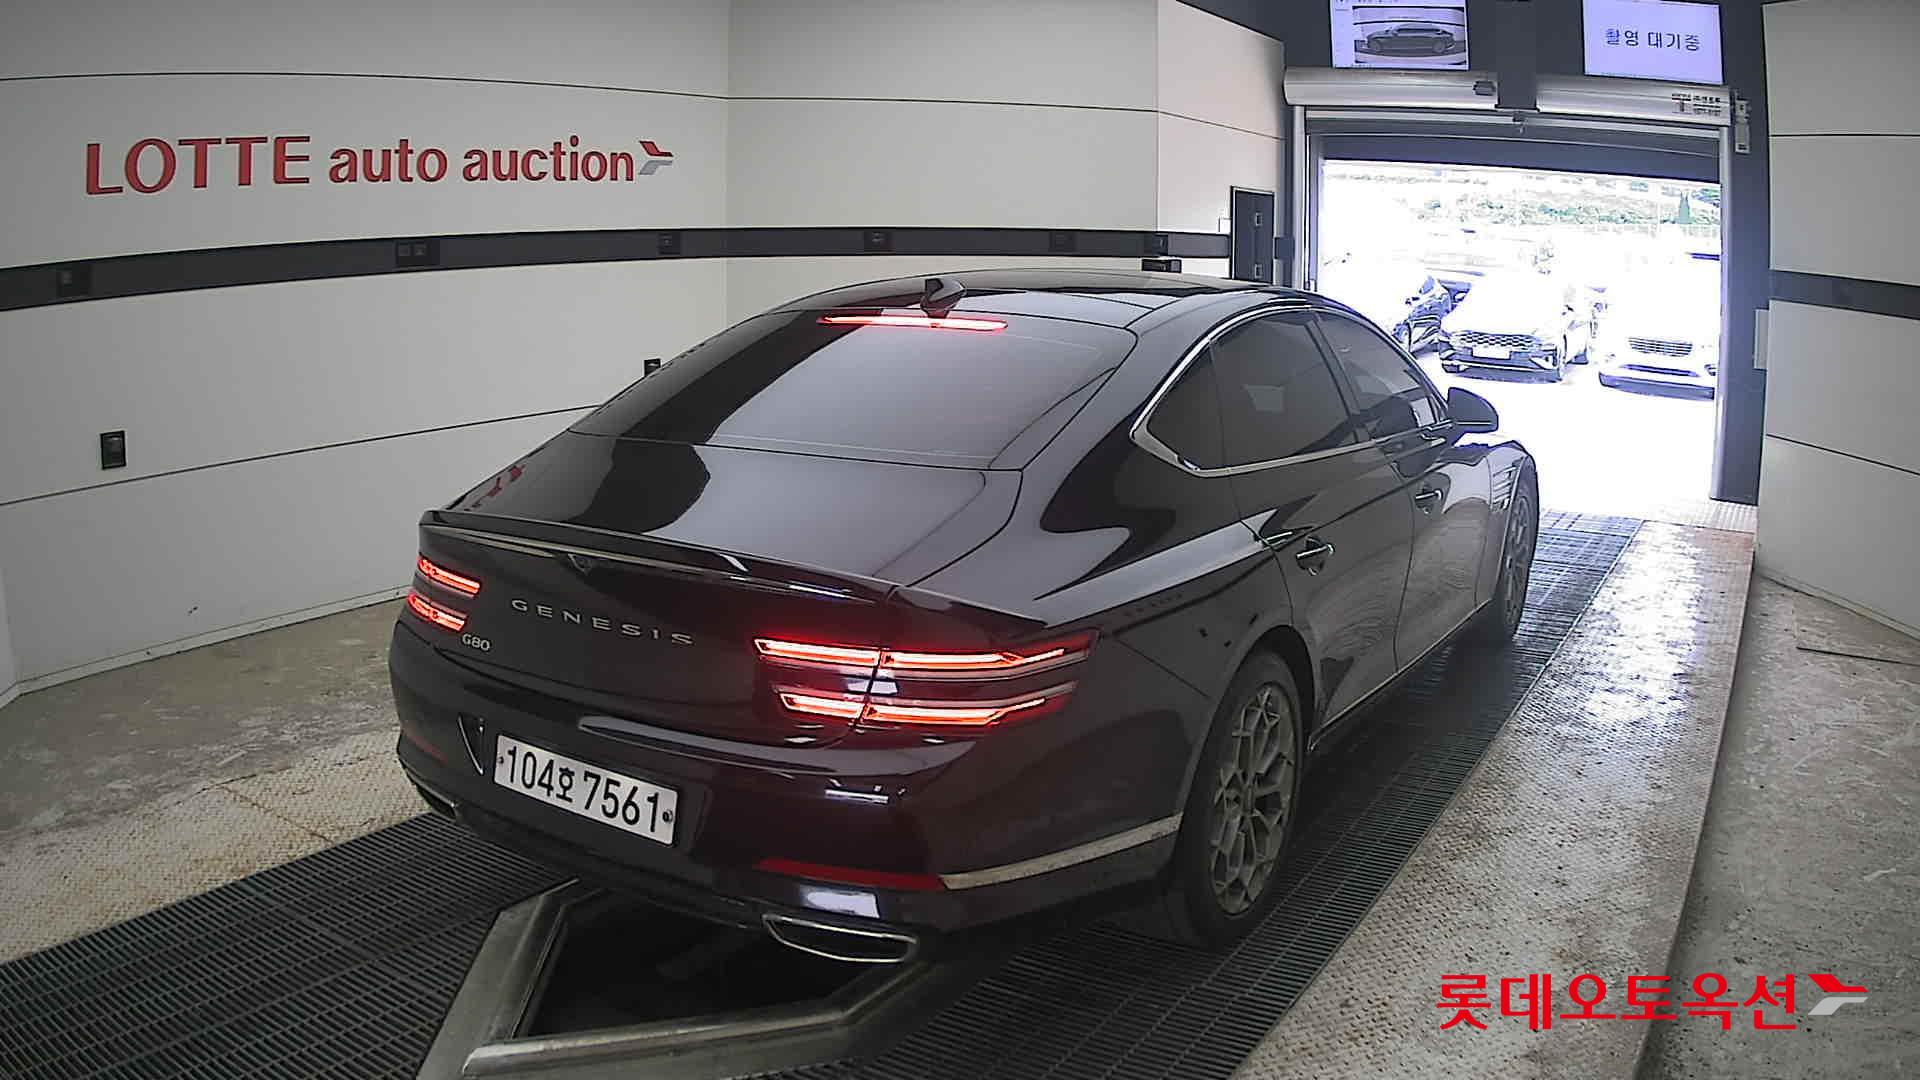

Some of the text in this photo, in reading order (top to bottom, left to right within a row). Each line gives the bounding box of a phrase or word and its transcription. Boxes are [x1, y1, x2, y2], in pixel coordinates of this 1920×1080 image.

[86, 135, 634, 195] LOTTE auto auction
[462, 633, 491, 651] G80
[511, 599, 695, 645] GENESIS
